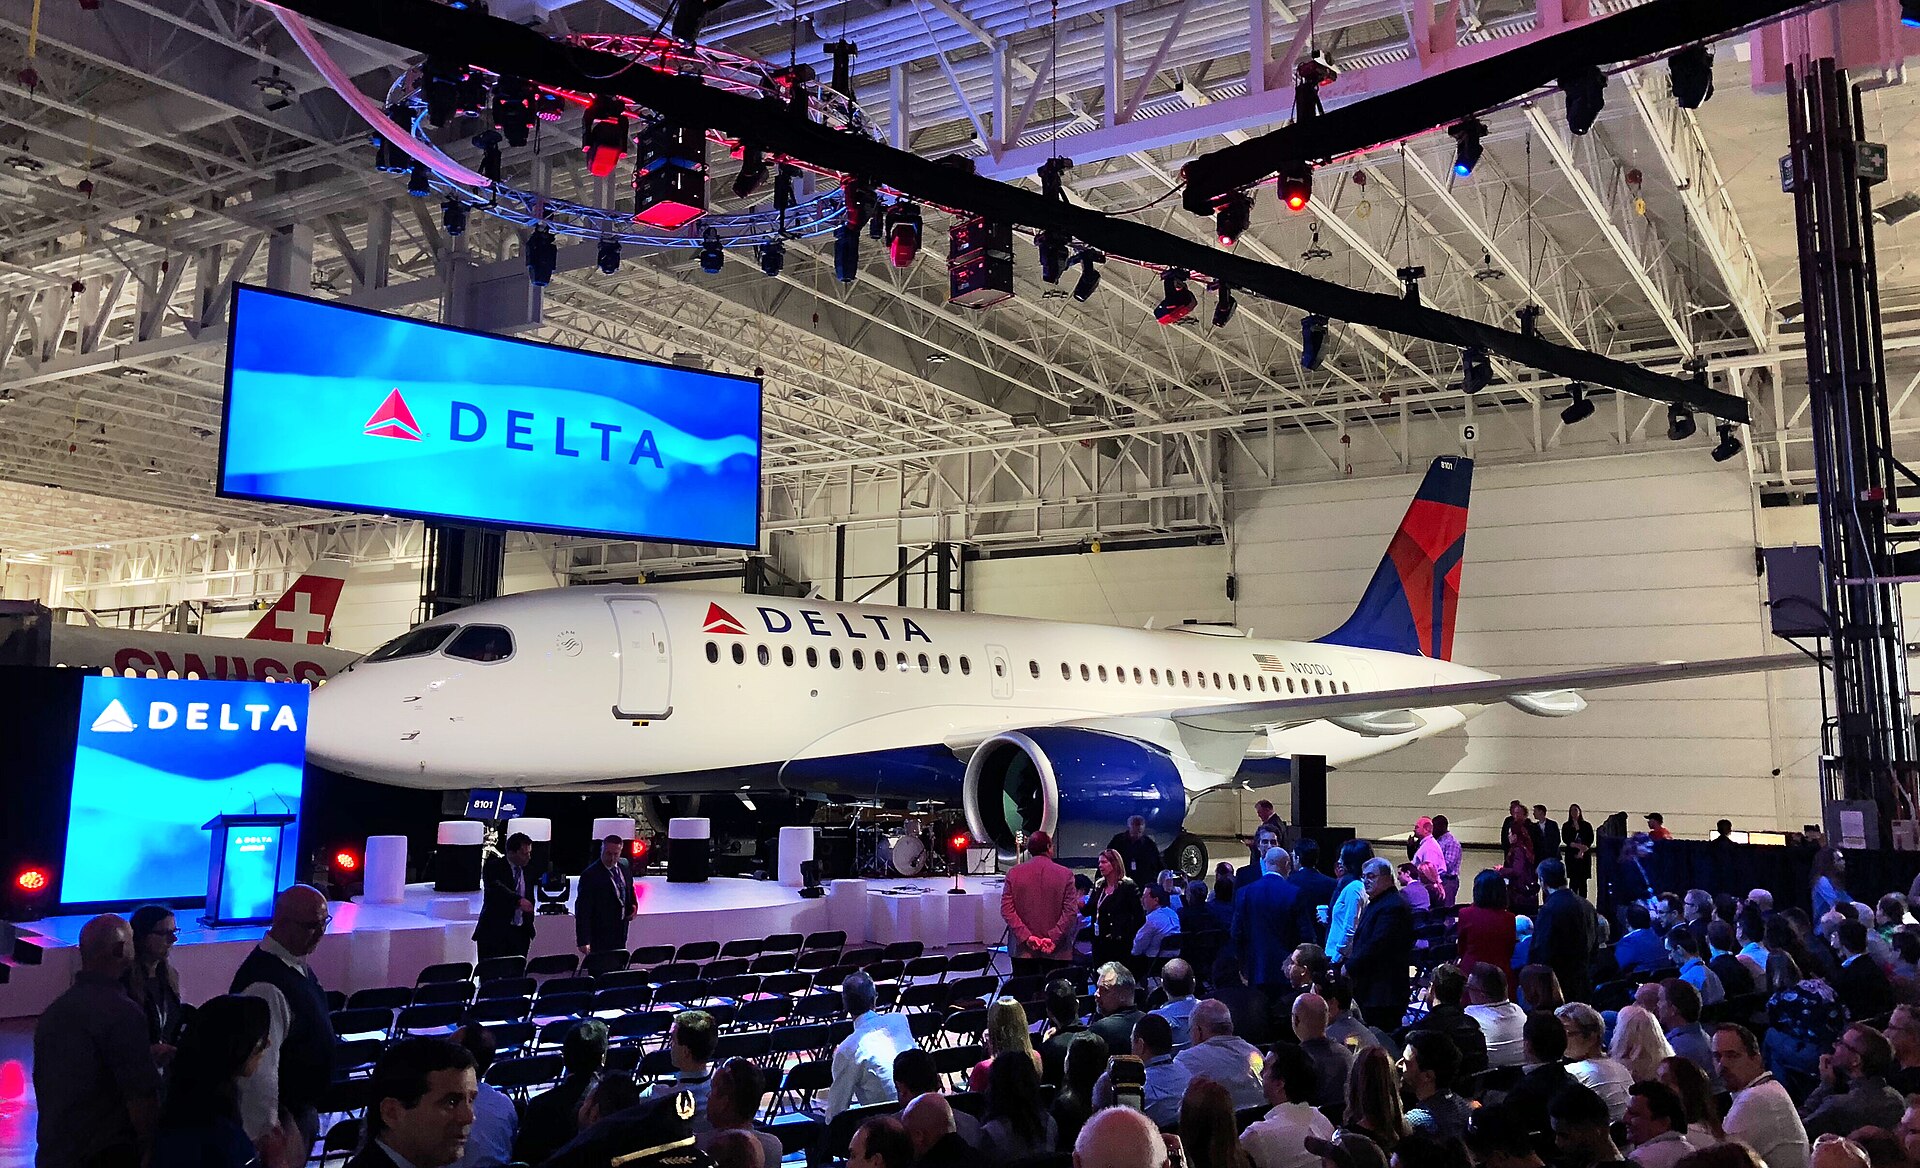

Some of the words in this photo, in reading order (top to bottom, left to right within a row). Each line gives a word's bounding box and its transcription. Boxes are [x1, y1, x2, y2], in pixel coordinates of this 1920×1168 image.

[449, 400, 665, 469] DELTA
[1463, 425, 1475, 440] 6
[1440, 460, 1453, 471] 8101
[755, 606, 933, 644] DELTA
[1289, 661, 1333, 676] N101DU
[148, 701, 298, 732] DELTA
[473, 799, 494, 809] 8101
